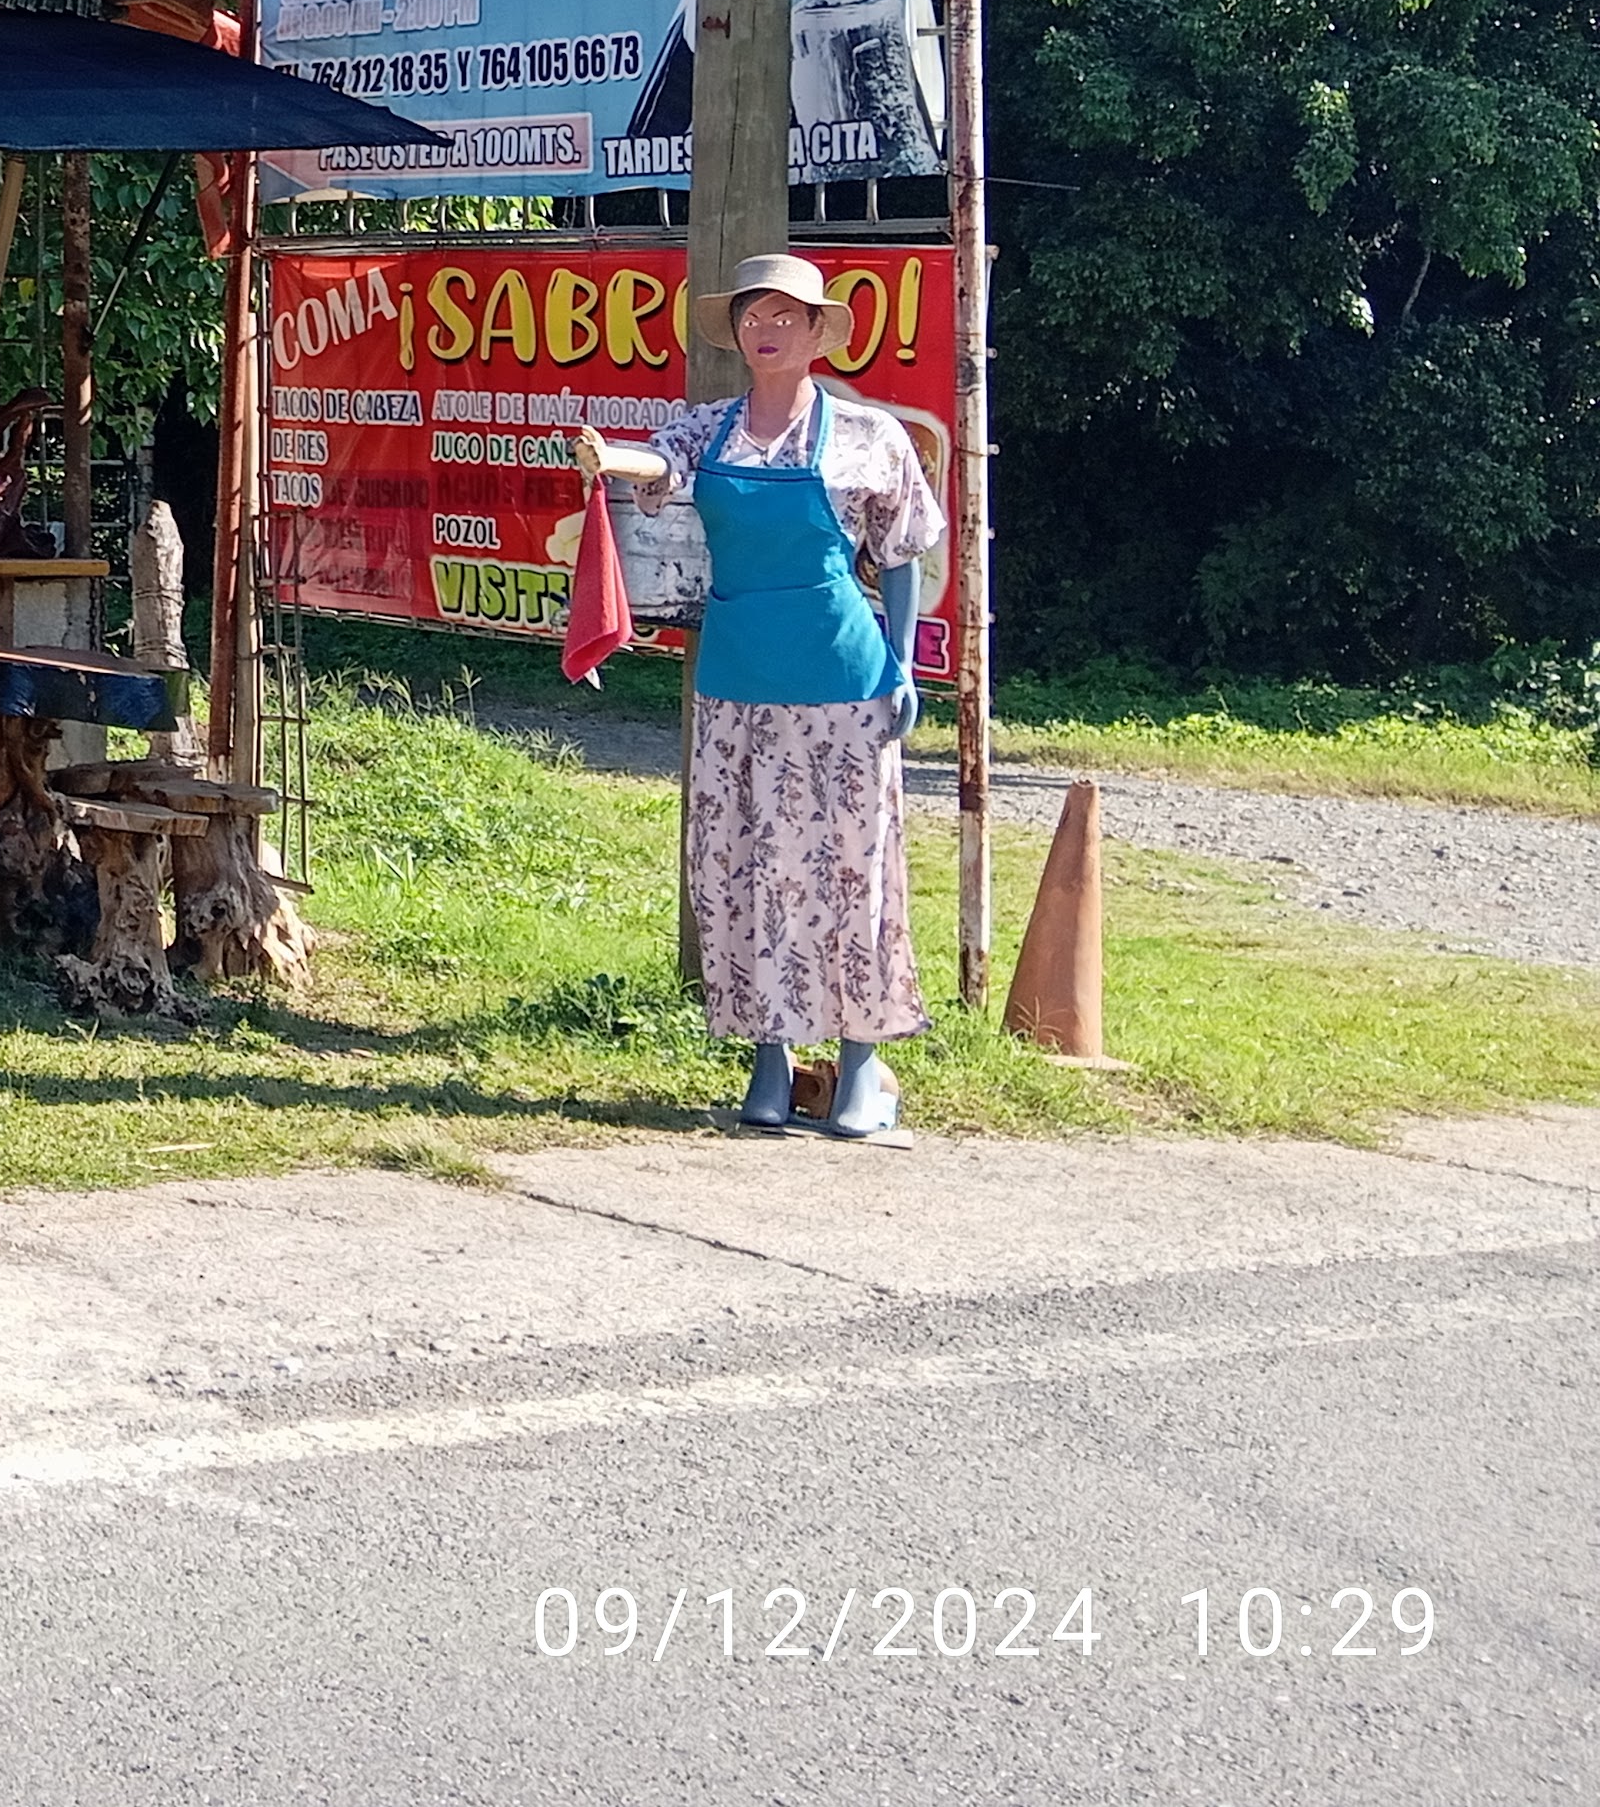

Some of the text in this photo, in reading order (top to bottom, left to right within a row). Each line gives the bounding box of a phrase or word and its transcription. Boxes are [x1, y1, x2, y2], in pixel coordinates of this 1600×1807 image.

[352, 57, 385, 92] 112
[389, 55, 414, 91] 18
[419, 53, 448, 89] 35
[457, 51, 471, 87] Y
[480, 47, 521, 85] 764
[526, 42, 568, 82] 105
[574, 38, 605, 79] 66
[611, 35, 639, 75] 73
[451, 130, 469, 166] A
[474, 125, 582, 166] 100MTS.
[810, 120, 880, 166] CITA
[273, 266, 398, 370] COMA
[399, 256, 922, 372] ¡SABRO!
[273, 389, 421, 422] TACOS DE CABEZA
[434, 393, 490, 419] ATOLE
[498, 395, 523, 421] DE
[530, 389, 582, 424] MAÍZ
[273, 432, 326, 461] DE RES
[433, 434, 482, 461] JUGO
[489, 437, 515, 462] DE
[273, 475, 321, 505] TACOS
[435, 517, 498, 546] POZOL
